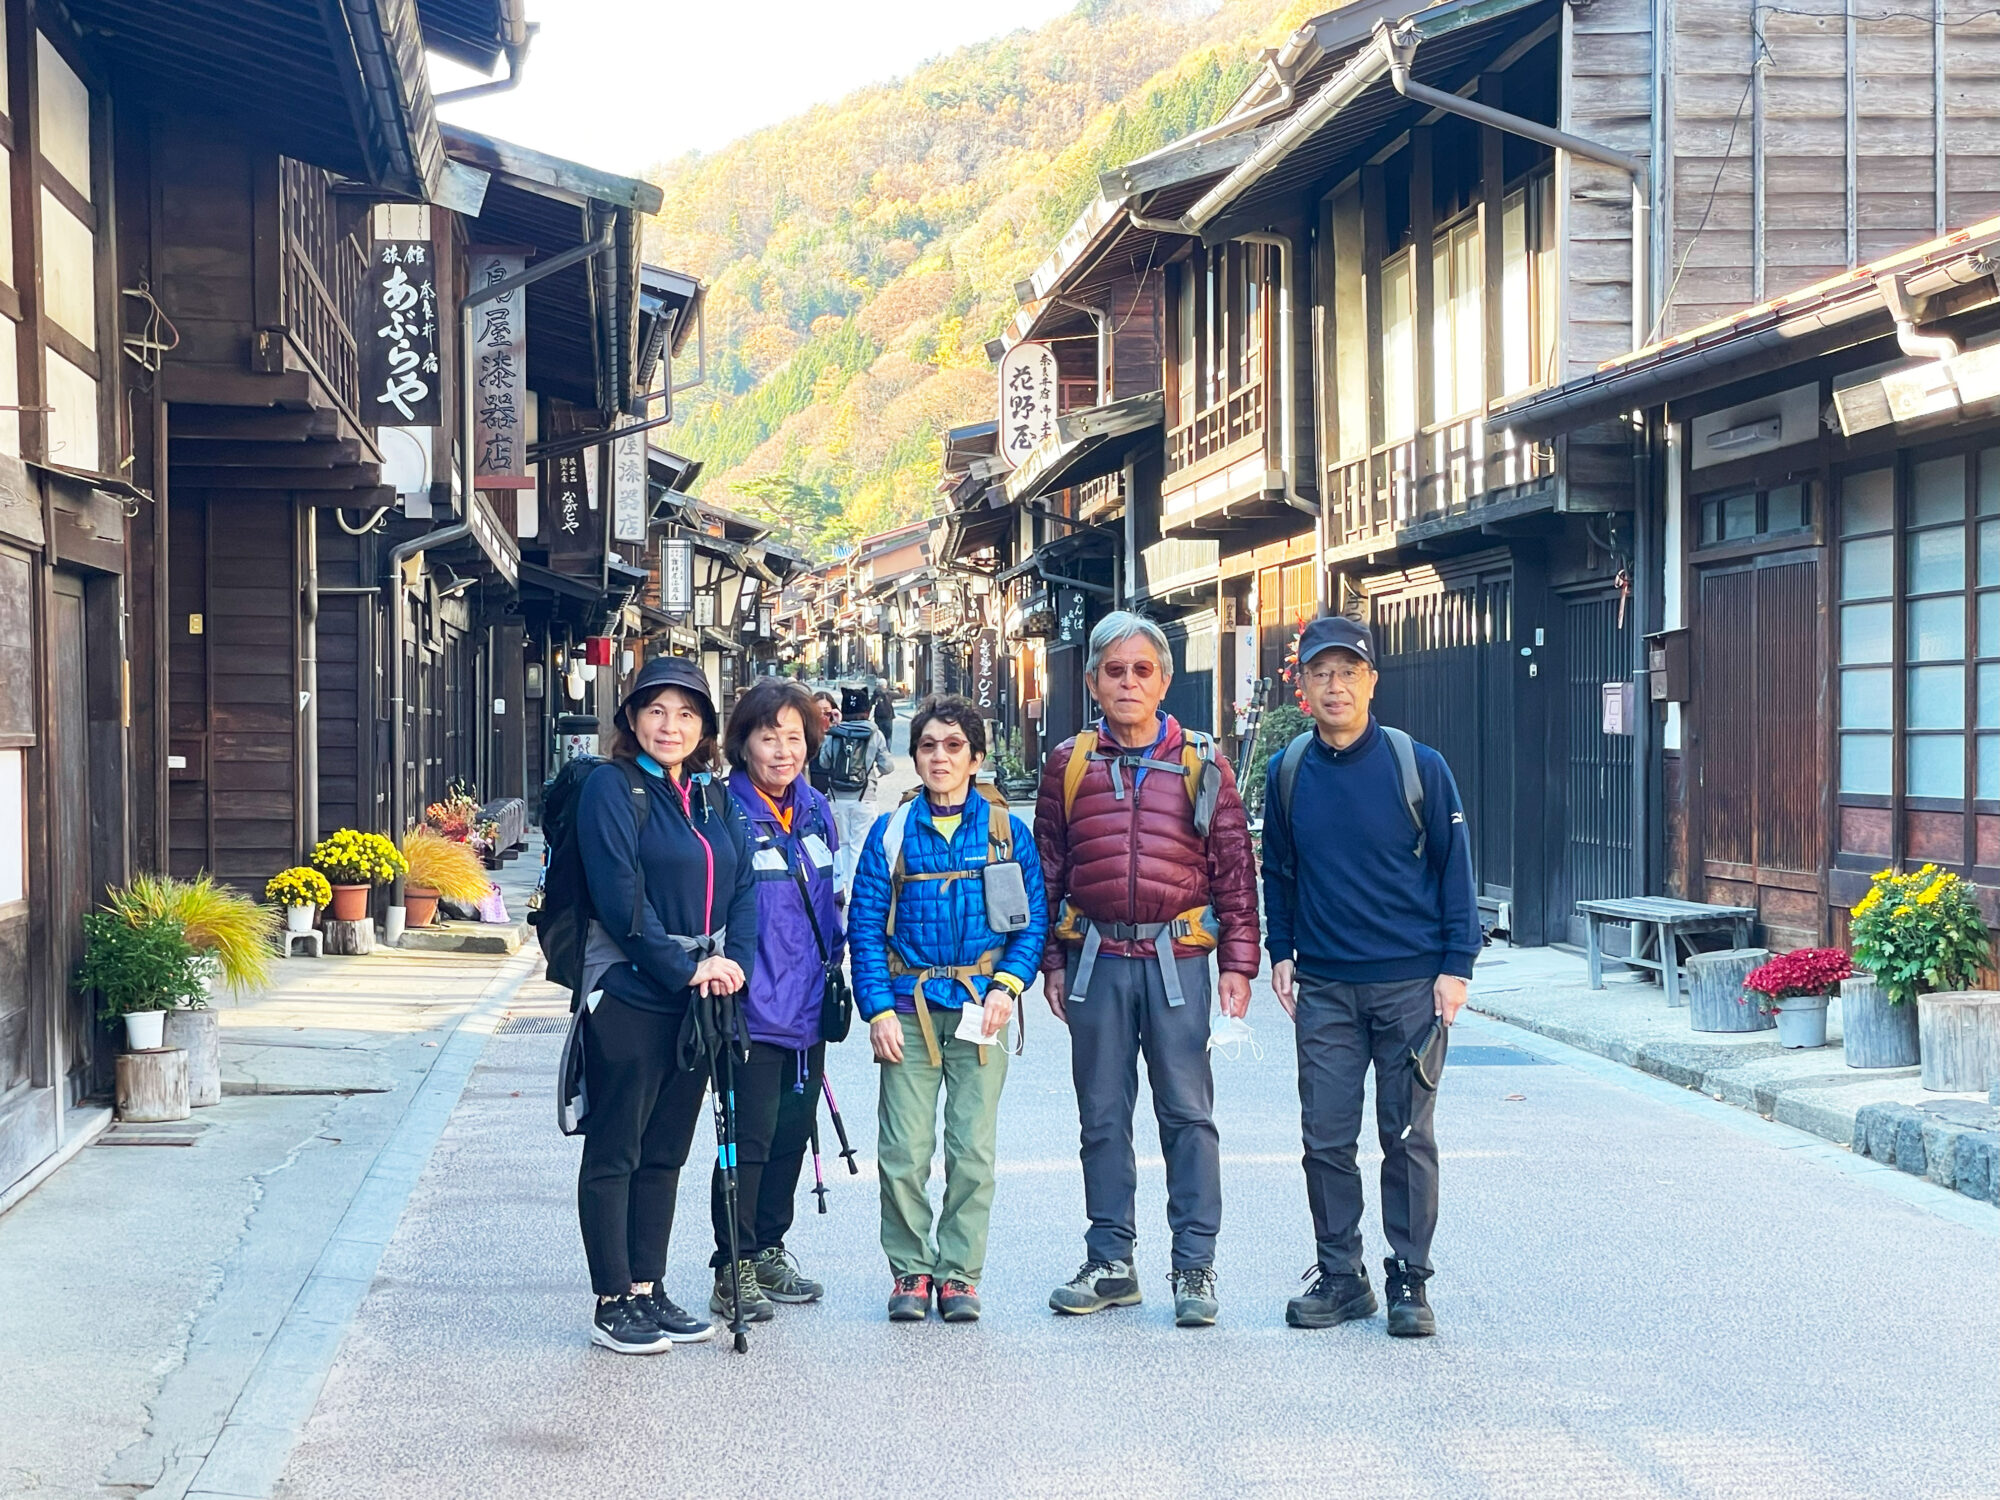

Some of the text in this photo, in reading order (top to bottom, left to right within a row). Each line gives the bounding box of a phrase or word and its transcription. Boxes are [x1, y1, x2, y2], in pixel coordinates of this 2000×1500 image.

[382, 245, 425, 265] 旅館
[377, 265, 428, 421] あぶらや
[419, 280, 438, 373] 奈良井宿
[1009, 365, 1036, 450] 花野屋
[562, 491, 579, 535] ながとや
